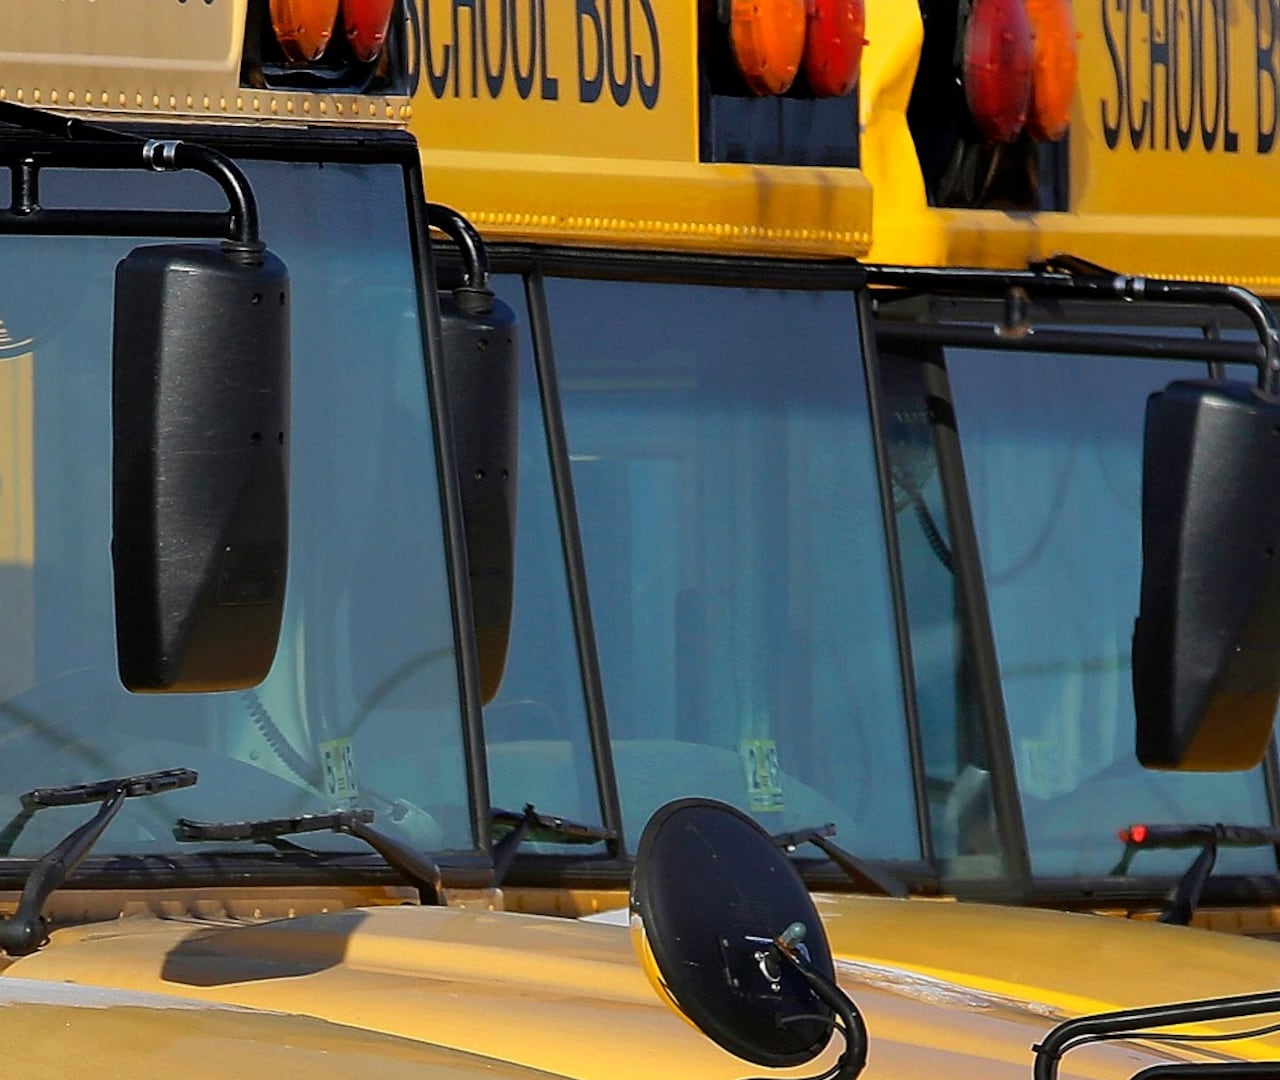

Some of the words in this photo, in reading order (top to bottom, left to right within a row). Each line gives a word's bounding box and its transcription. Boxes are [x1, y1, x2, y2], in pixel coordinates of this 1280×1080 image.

[406, 0, 558, 100] CHOOL
[575, 0, 660, 110] BUS
[1100, 0, 1239, 153] SCHOOL
